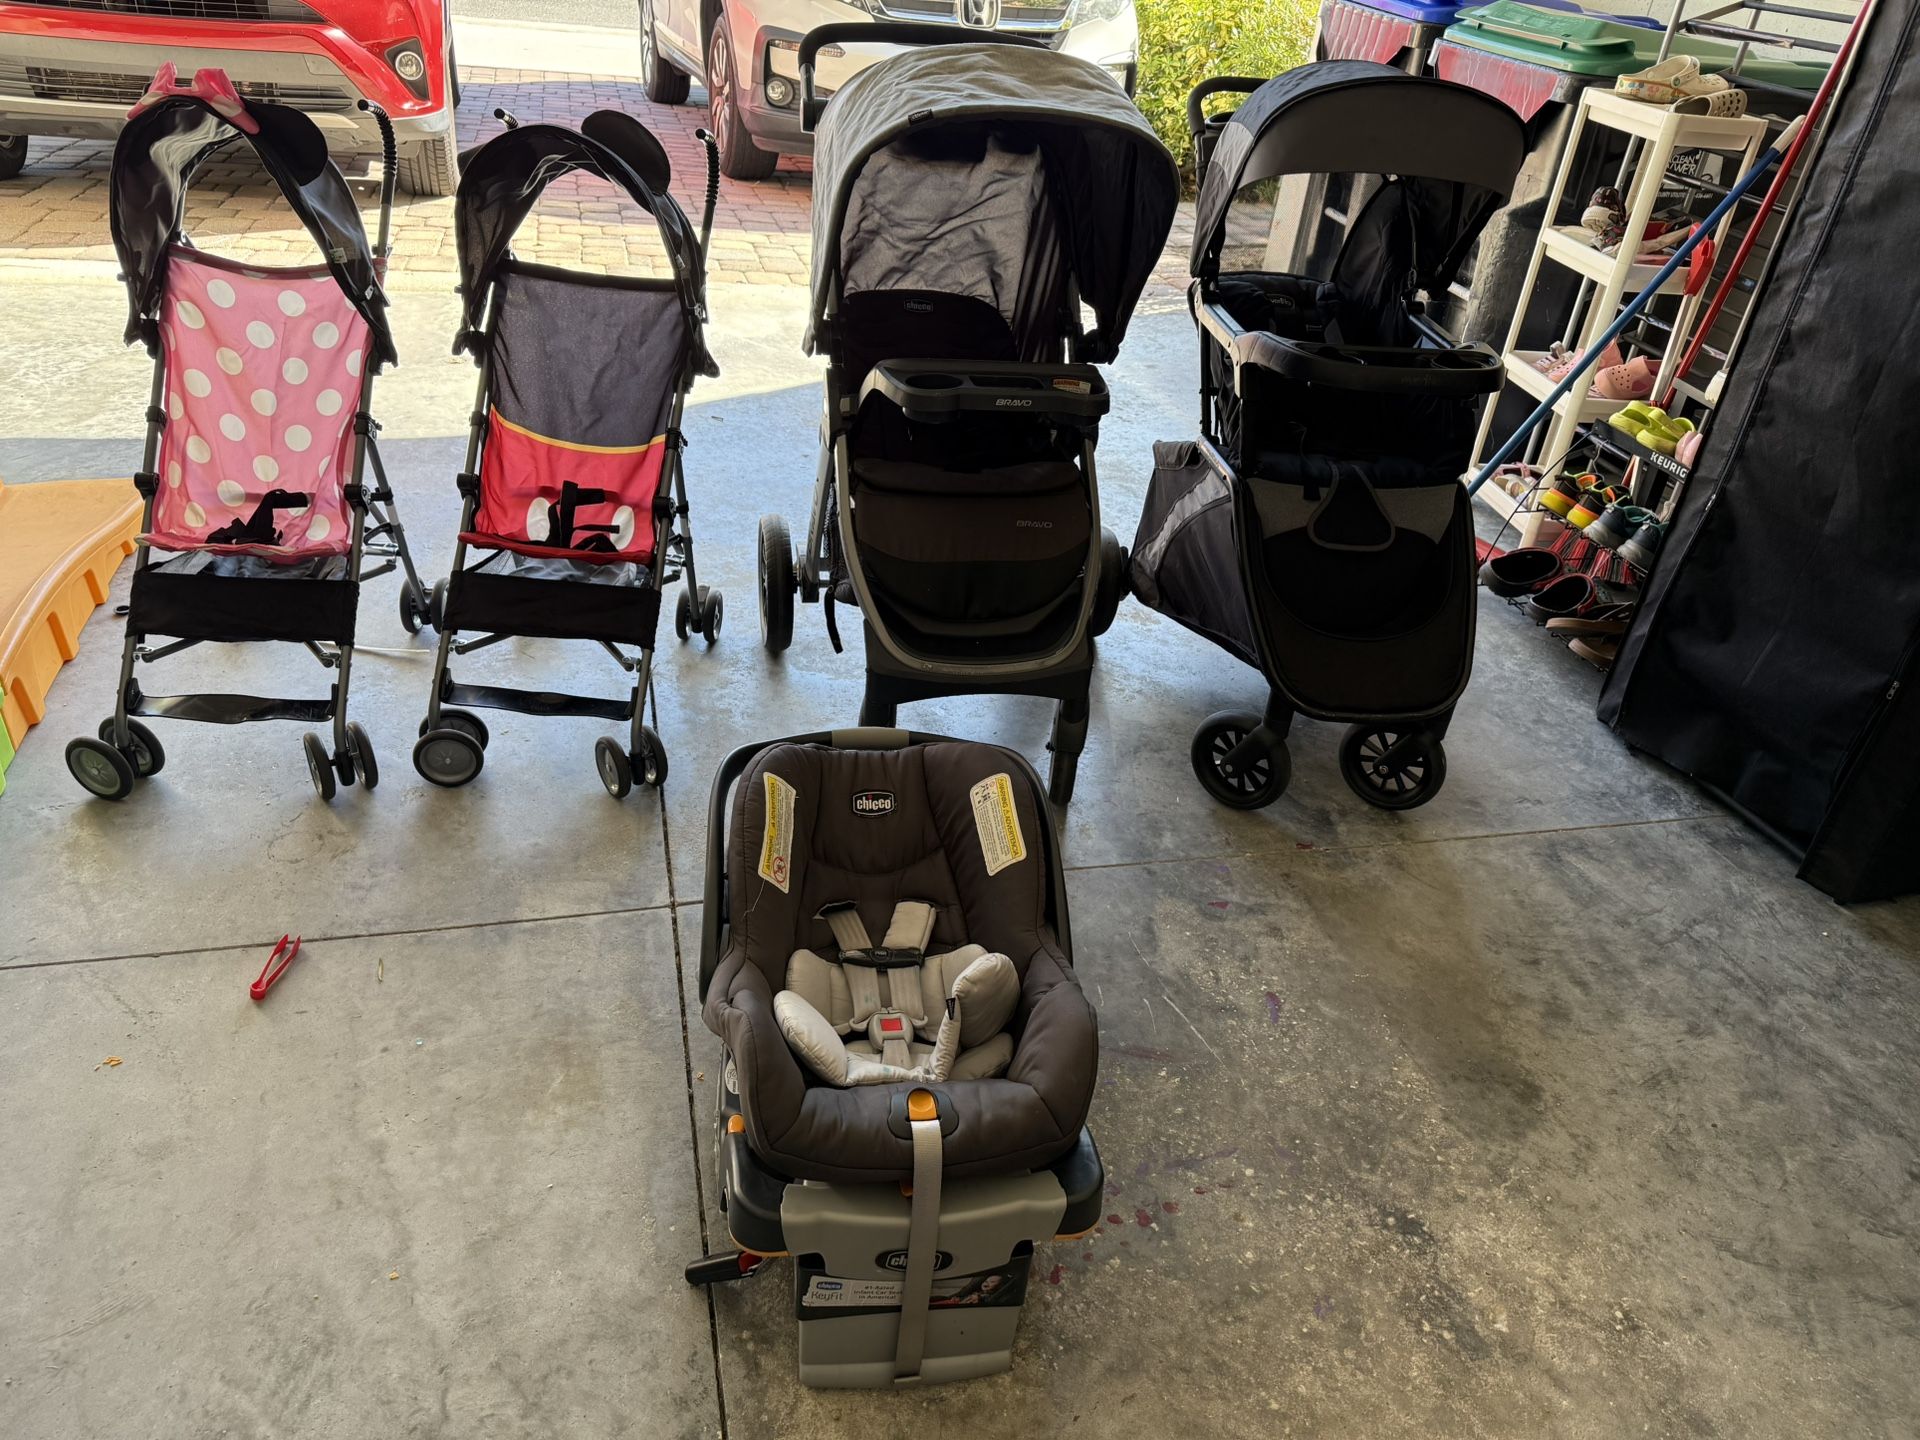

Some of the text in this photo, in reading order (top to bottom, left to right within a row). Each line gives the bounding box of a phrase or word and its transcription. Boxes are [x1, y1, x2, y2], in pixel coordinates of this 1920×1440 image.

[995, 398, 1032, 407] BRAVO
[1650, 451, 1687, 478] KEURIG
[1016, 520, 1053, 528] BRAVO
[856, 795, 892, 811] chicco
[999, 784, 1019, 856] WARNING ADVERTENCIA
[811, 1291, 843, 1301] KeyFit
